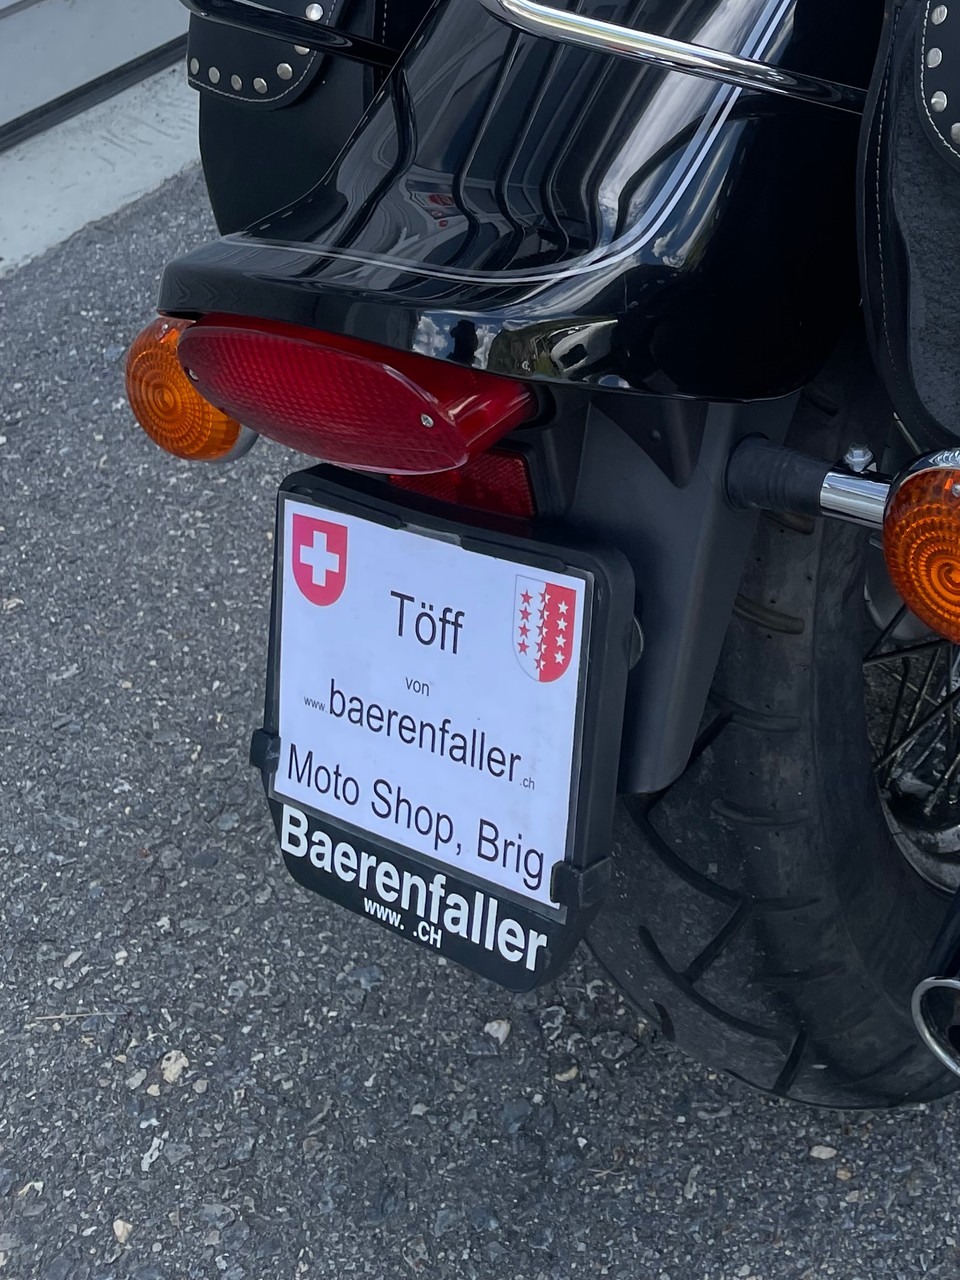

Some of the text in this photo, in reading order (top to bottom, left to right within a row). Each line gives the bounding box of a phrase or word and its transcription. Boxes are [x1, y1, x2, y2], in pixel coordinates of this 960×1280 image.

[390, 590, 465, 655] Töff
[405, 676, 430, 697] von
[287, 742, 544, 891] Moto Shop, Brig
[280, 803, 548, 972] Baerenfaller
[364, 897, 443, 949] www. .CH
